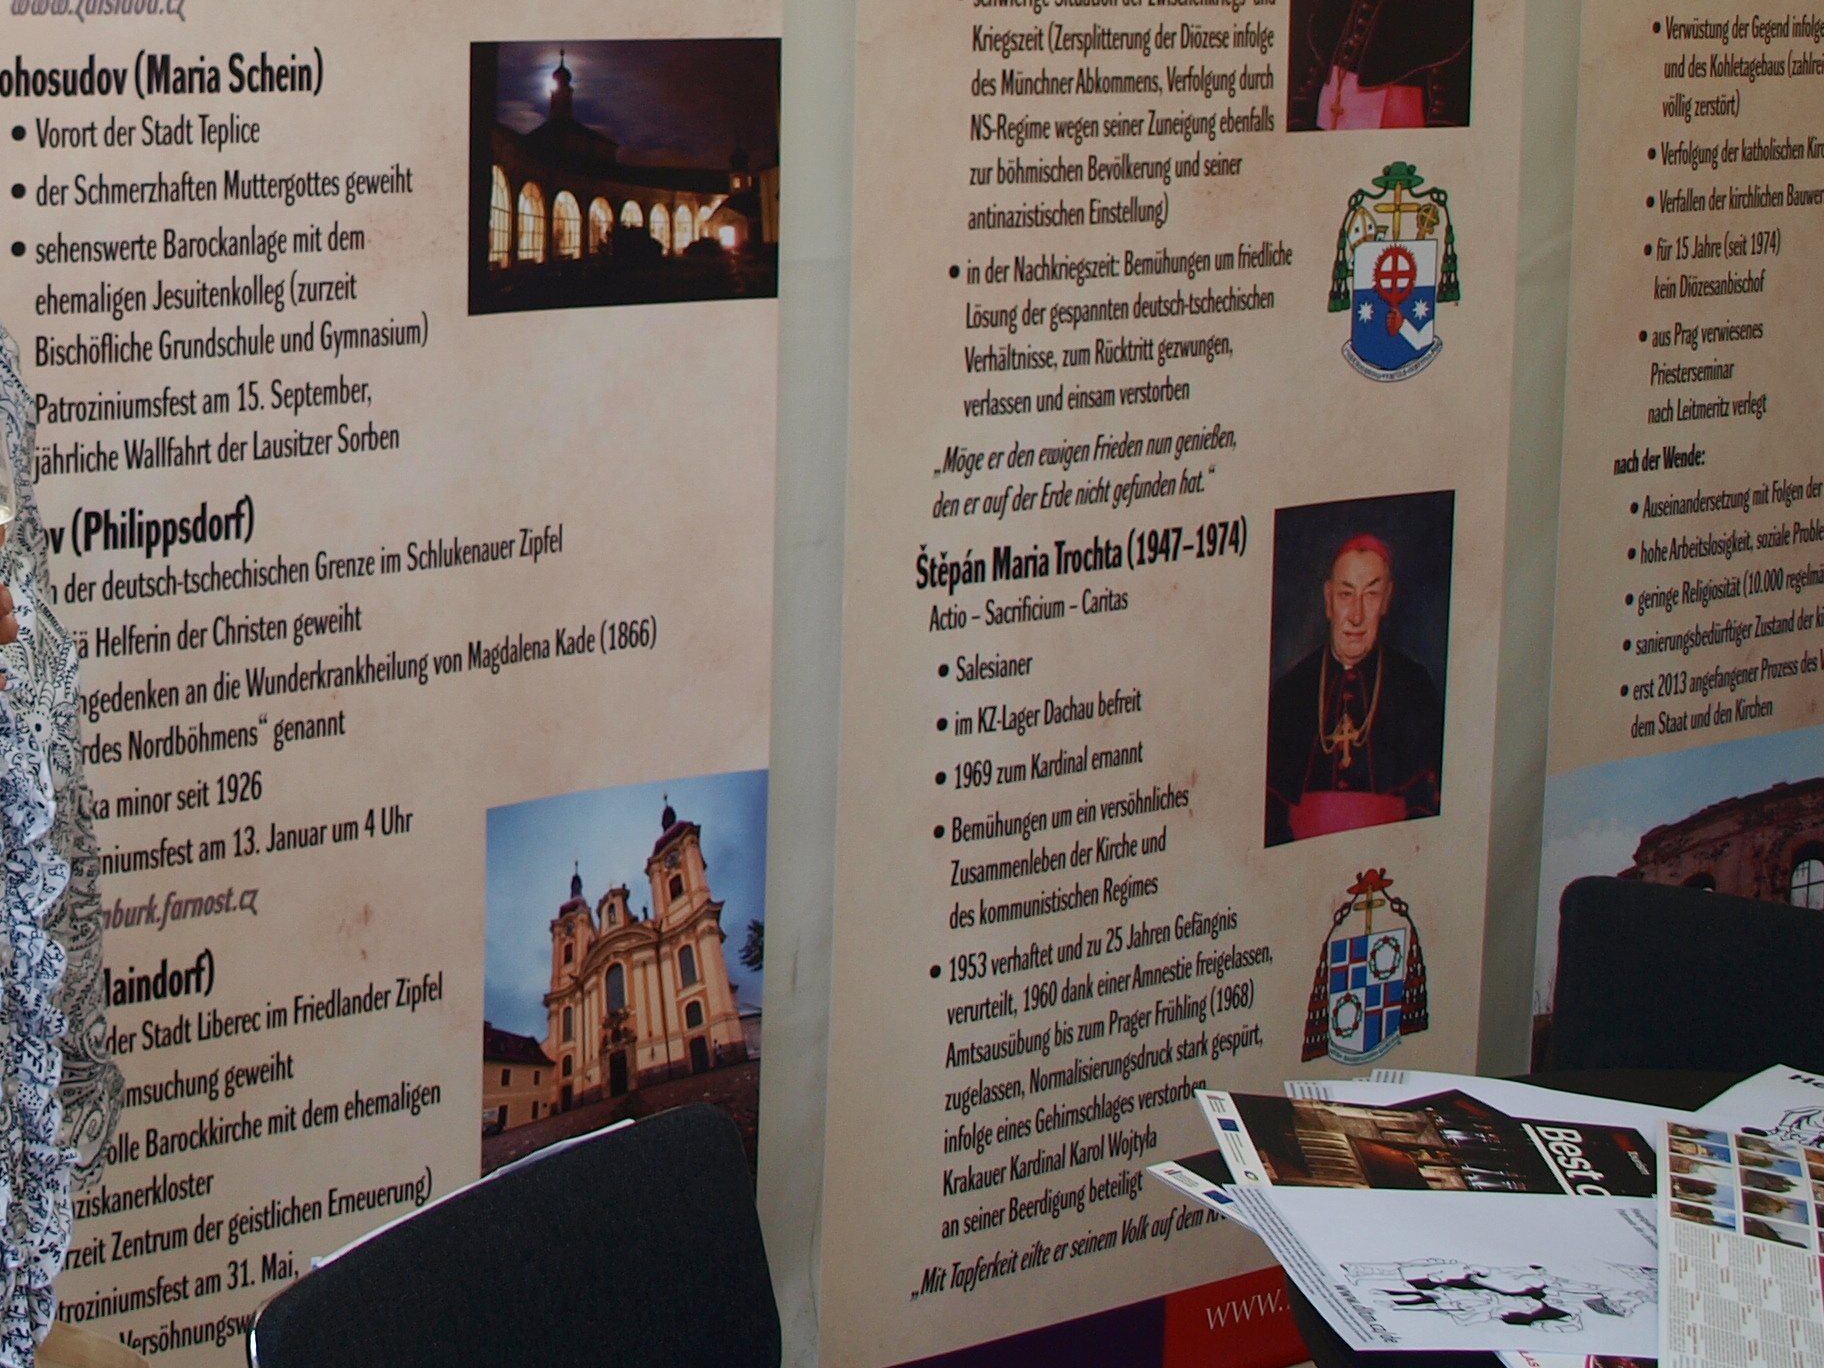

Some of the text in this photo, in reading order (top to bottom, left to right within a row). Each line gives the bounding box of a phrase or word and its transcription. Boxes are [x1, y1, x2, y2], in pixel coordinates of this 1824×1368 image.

[134, 49, 220, 99] (Maria
[228, 46, 323, 95] Schein)
[36, 163, 412, 206] der Schmerzhaften Muttergottes geweiht
[1656, 237, 1672, 261] für
[1675, 235, 1688, 260] 15
[1691, 233, 1721, 258] Jahre
[1654, 268, 1765, 299] kein Diözesanbischof
[35, 311, 428, 366] Bischöfliche Grundschule und Gymnasium)
[963, 375, 1189, 416] verlassen und einsam verstorben
[1650, 358, 1734, 385] Priesterseminar
[33, 420, 399, 485] jährliche Wallfahrt der Lausitzer Sorben
[1613, 448, 1639, 475] nach
[1641, 447, 1661, 471] der
[71, 495, 254, 558] (Philippsdorf)
[64, 523, 562, 603] der deutsch-tschechischen Grenze im Schlukenauer Zipfel
[916, 544, 985, 595] Štěpán
[992, 544, 1049, 581] Maria
[1054, 535, 1122, 574] Trochta
[956, 653, 1032, 682] Salesianer
[955, 687, 1141, 736] im KZ-Lager Dachau befreit
[955, 741, 1143, 789] 1969 zum Kardinal ernannt
[106, 971, 442, 1055] der Stadt Liberec im Friedlander Zipfel
[943, 1165, 1006, 1196] Krakauer
[1010, 1143, 1065, 1181] Kardinal
[1069, 1134, 1104, 1167] Karol
[1536, 1126, 1605, 1181] Best
[1205, 1289, 1289, 1330] www.
